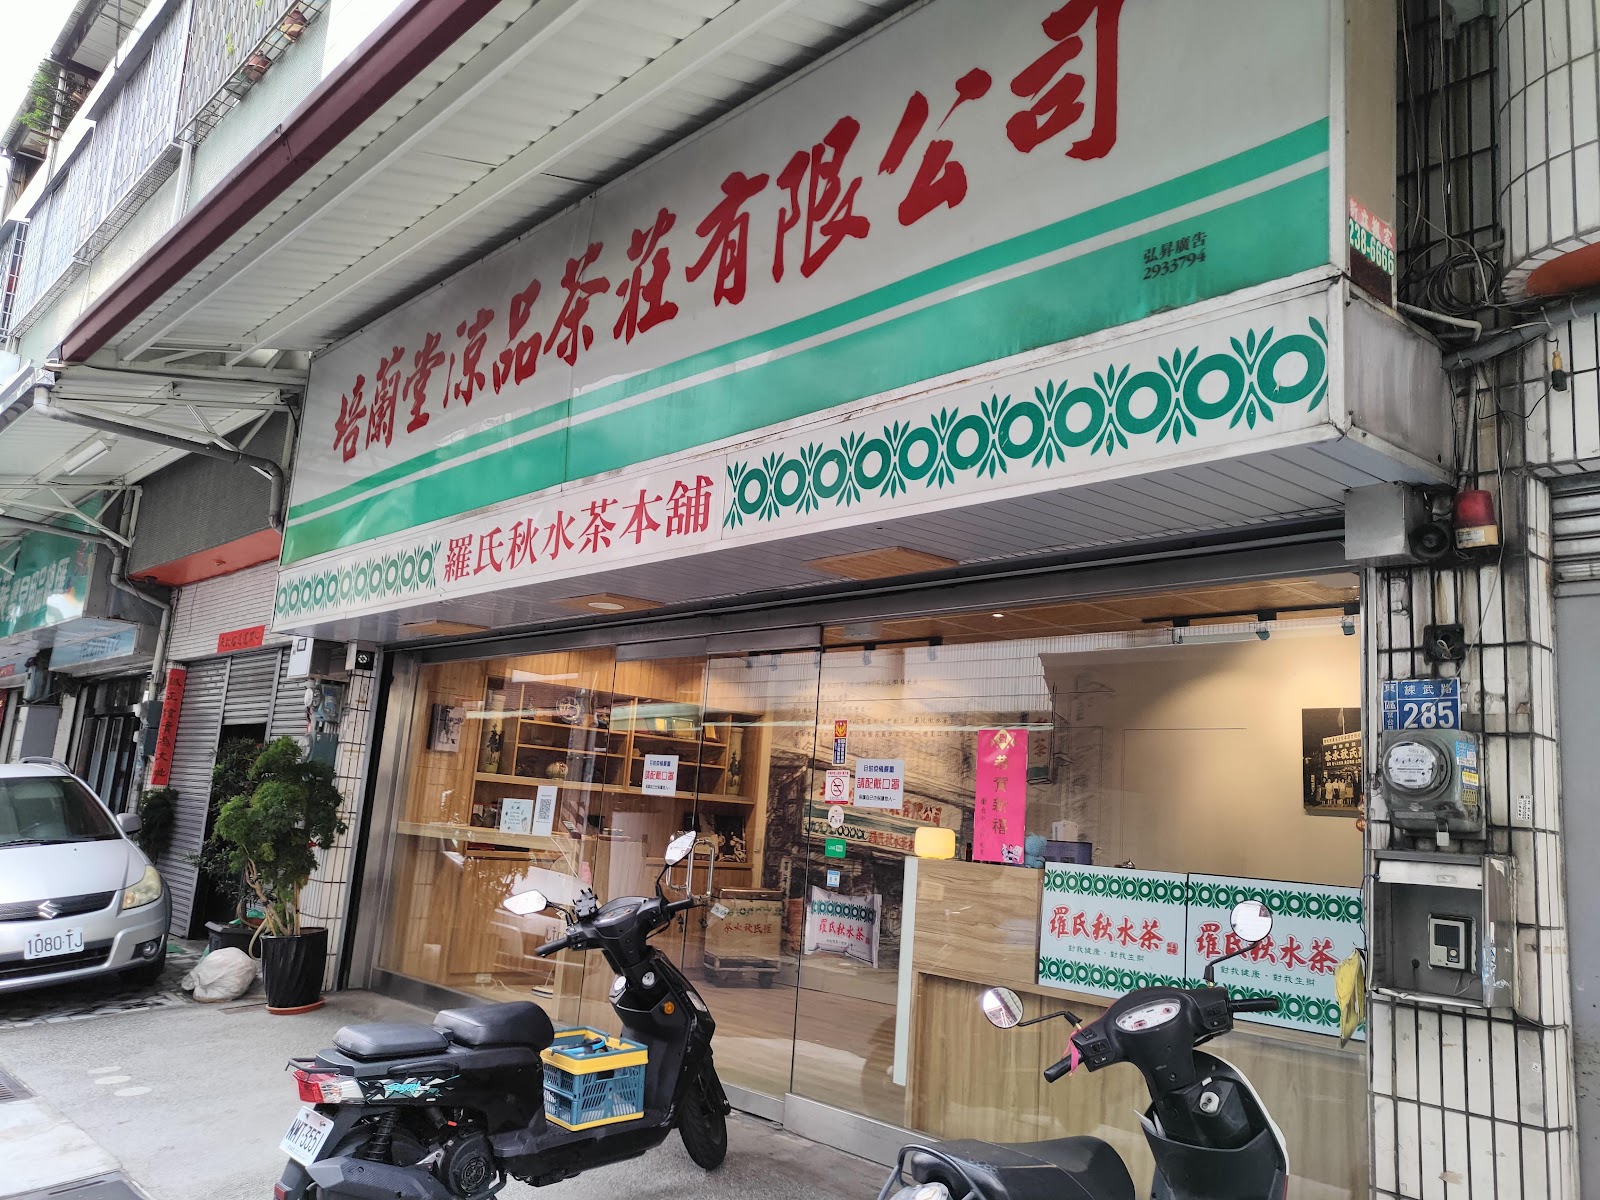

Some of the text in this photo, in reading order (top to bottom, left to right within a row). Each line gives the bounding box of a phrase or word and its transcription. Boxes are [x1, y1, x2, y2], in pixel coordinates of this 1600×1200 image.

[1349, 218, 1395, 276] 238-6666
[1142, 248, 1206, 280] 2933794
[443, 475, 714, 583] 羅氏秋水茶本舖
[1404, 683, 1453, 696] 練武路
[1403, 701, 1455, 729] 285
[818, 918, 865, 941] 羅氏秋水茶
[1049, 906, 1164, 951] 羅氏秋水茶
